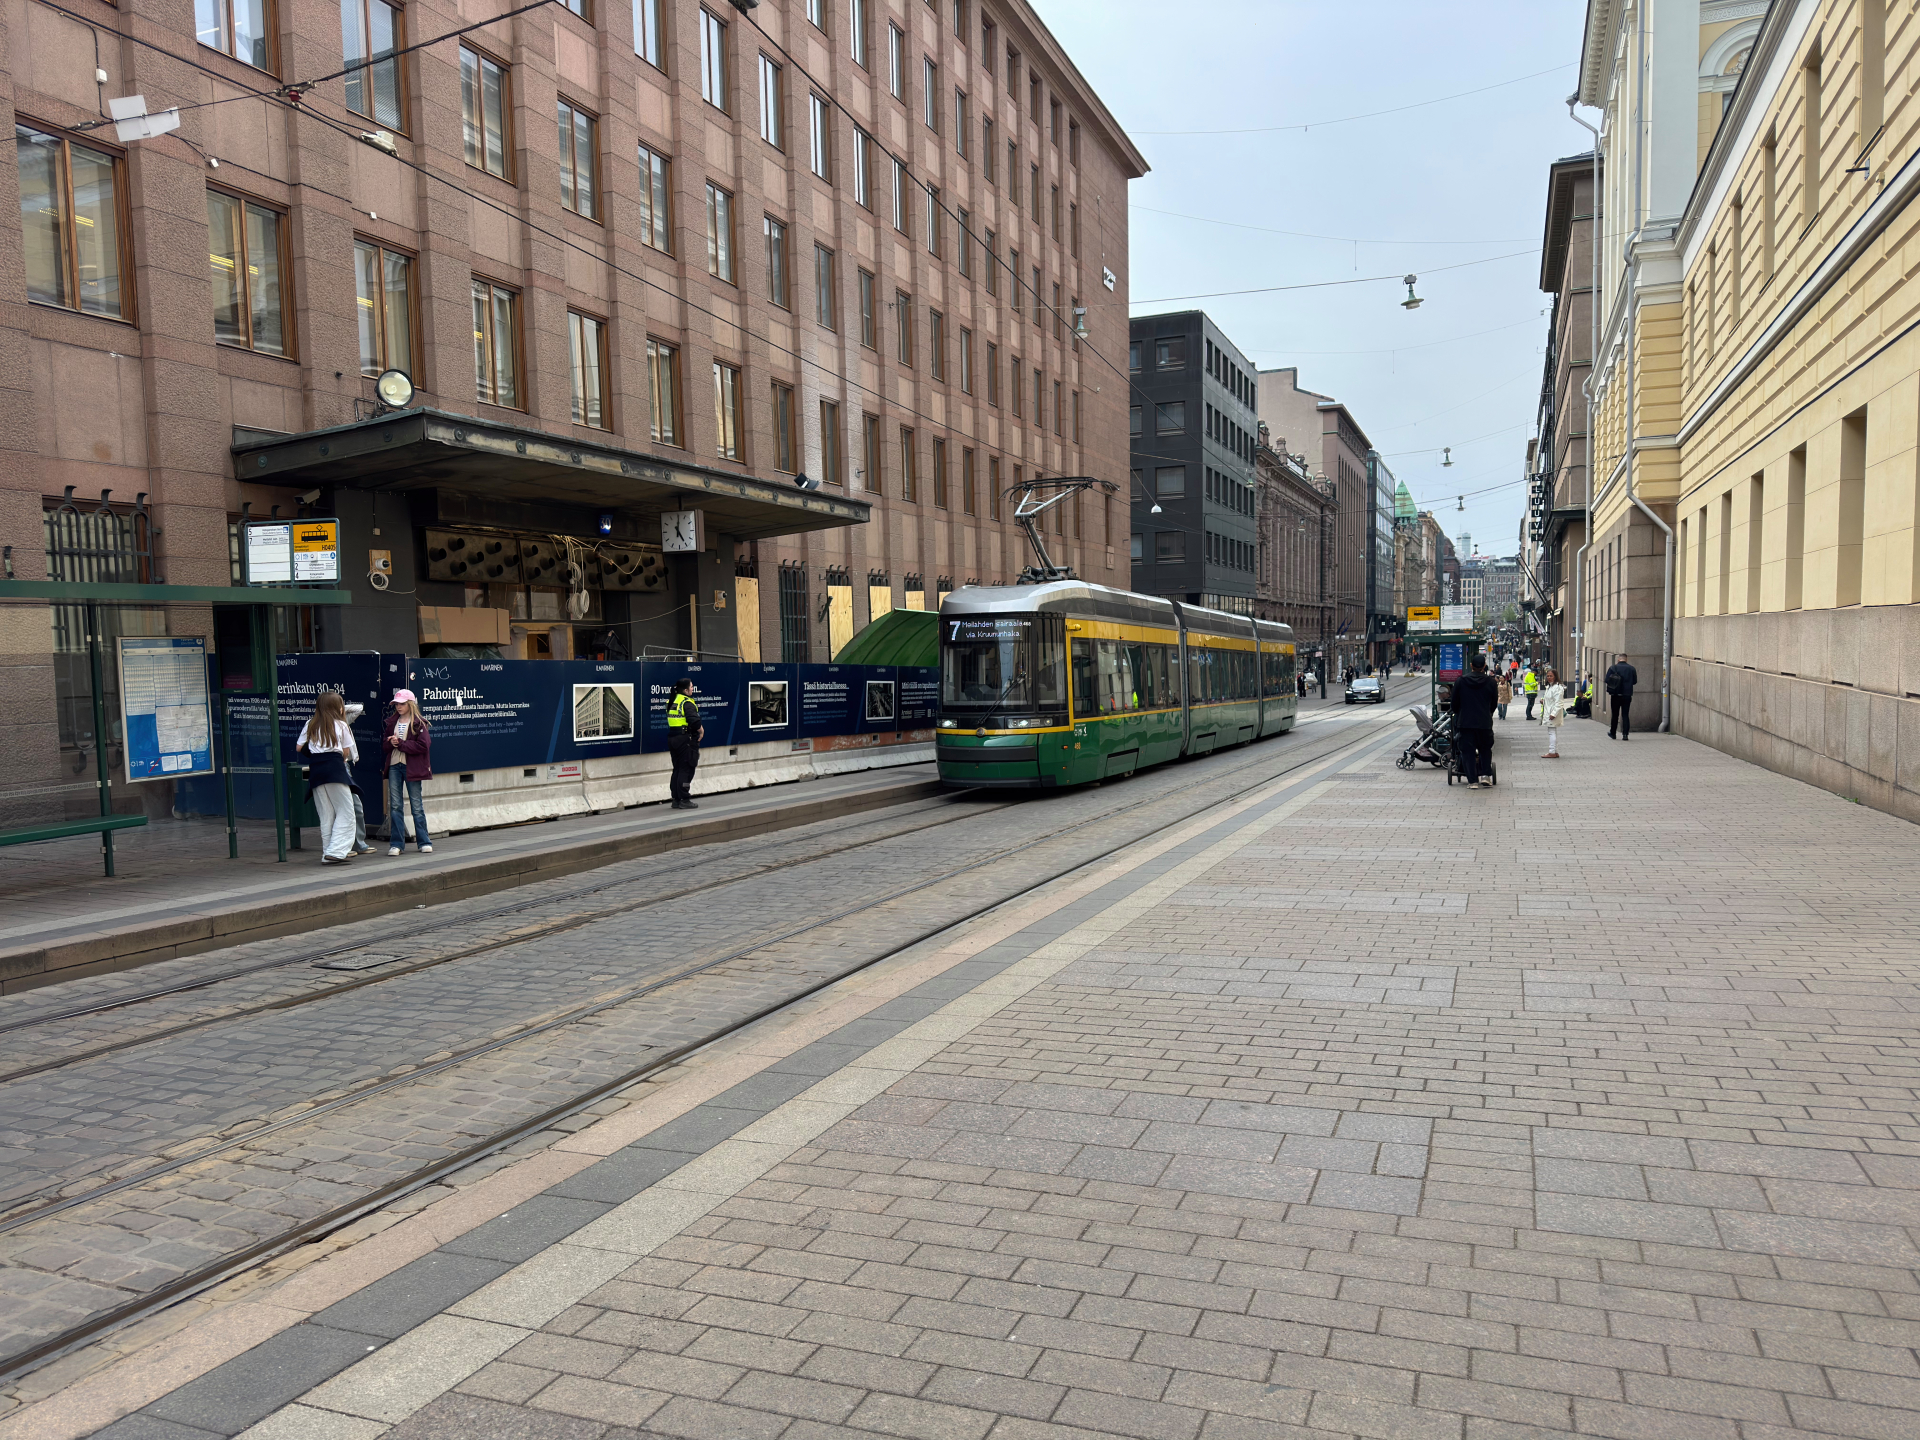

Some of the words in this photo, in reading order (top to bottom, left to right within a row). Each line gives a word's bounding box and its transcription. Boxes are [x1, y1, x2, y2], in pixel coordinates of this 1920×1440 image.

[248, 528, 253, 536] 5
[249, 537, 253, 545] 7
[949, 620, 961, 641] 7
[977, 630, 1020, 638] Kruununhaka
[277, 681, 316, 694] erinkatu
[650, 684, 660, 694] 90
[423, 687, 484, 700] Pahoittelut...
